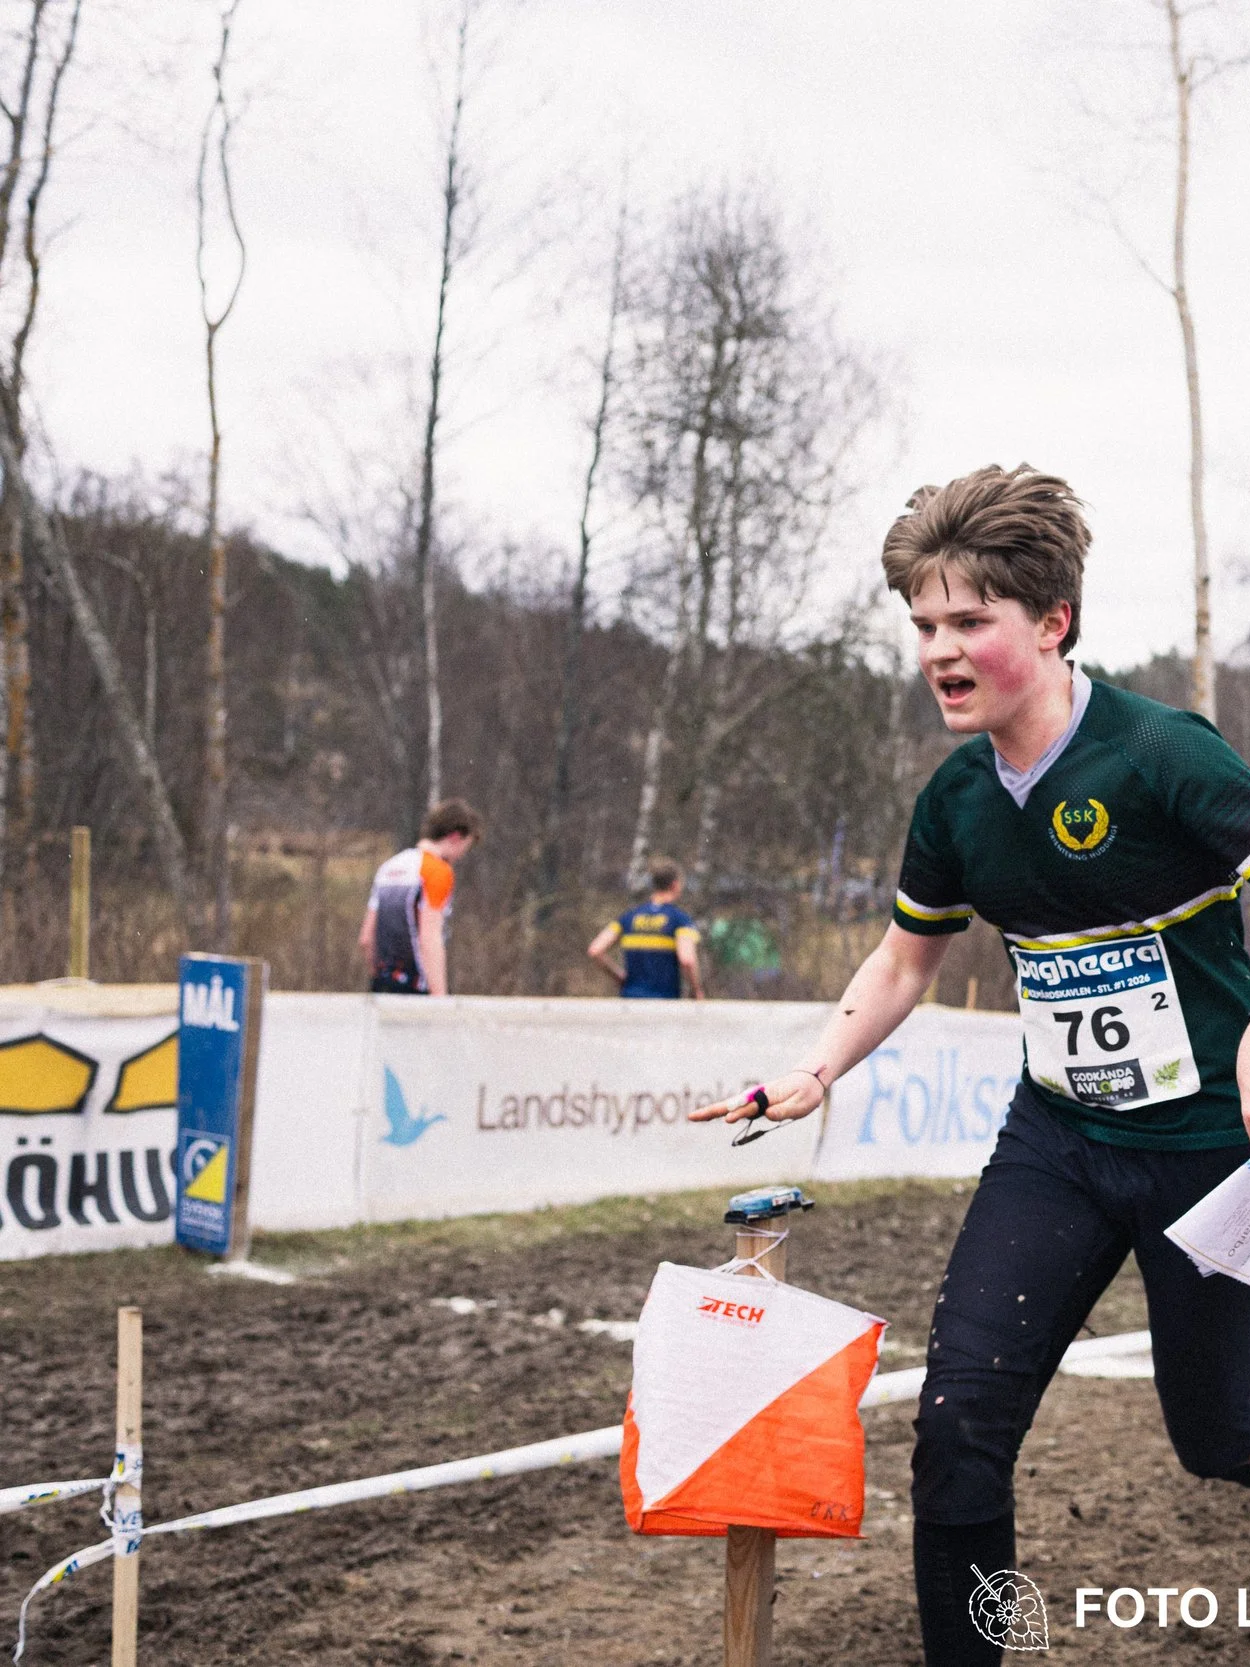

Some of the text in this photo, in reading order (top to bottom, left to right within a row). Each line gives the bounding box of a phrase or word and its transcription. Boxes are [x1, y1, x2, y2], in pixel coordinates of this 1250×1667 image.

[1064, 809, 1094, 824] SSK
[1018, 945, 1161, 986] bagheera
[1097, 983, 1113, 994] STL
[1114, 980, 1126, 990] #1
[1128, 973, 1151, 988] 2026
[182, 974, 240, 1031] MÅL
[1151, 991, 1169, 1011] 2
[1053, 1006, 1130, 1056] 76
[1072, 1066, 1134, 1083] GODKÄNDA
[0, 1137, 178, 1230] ÖHU
